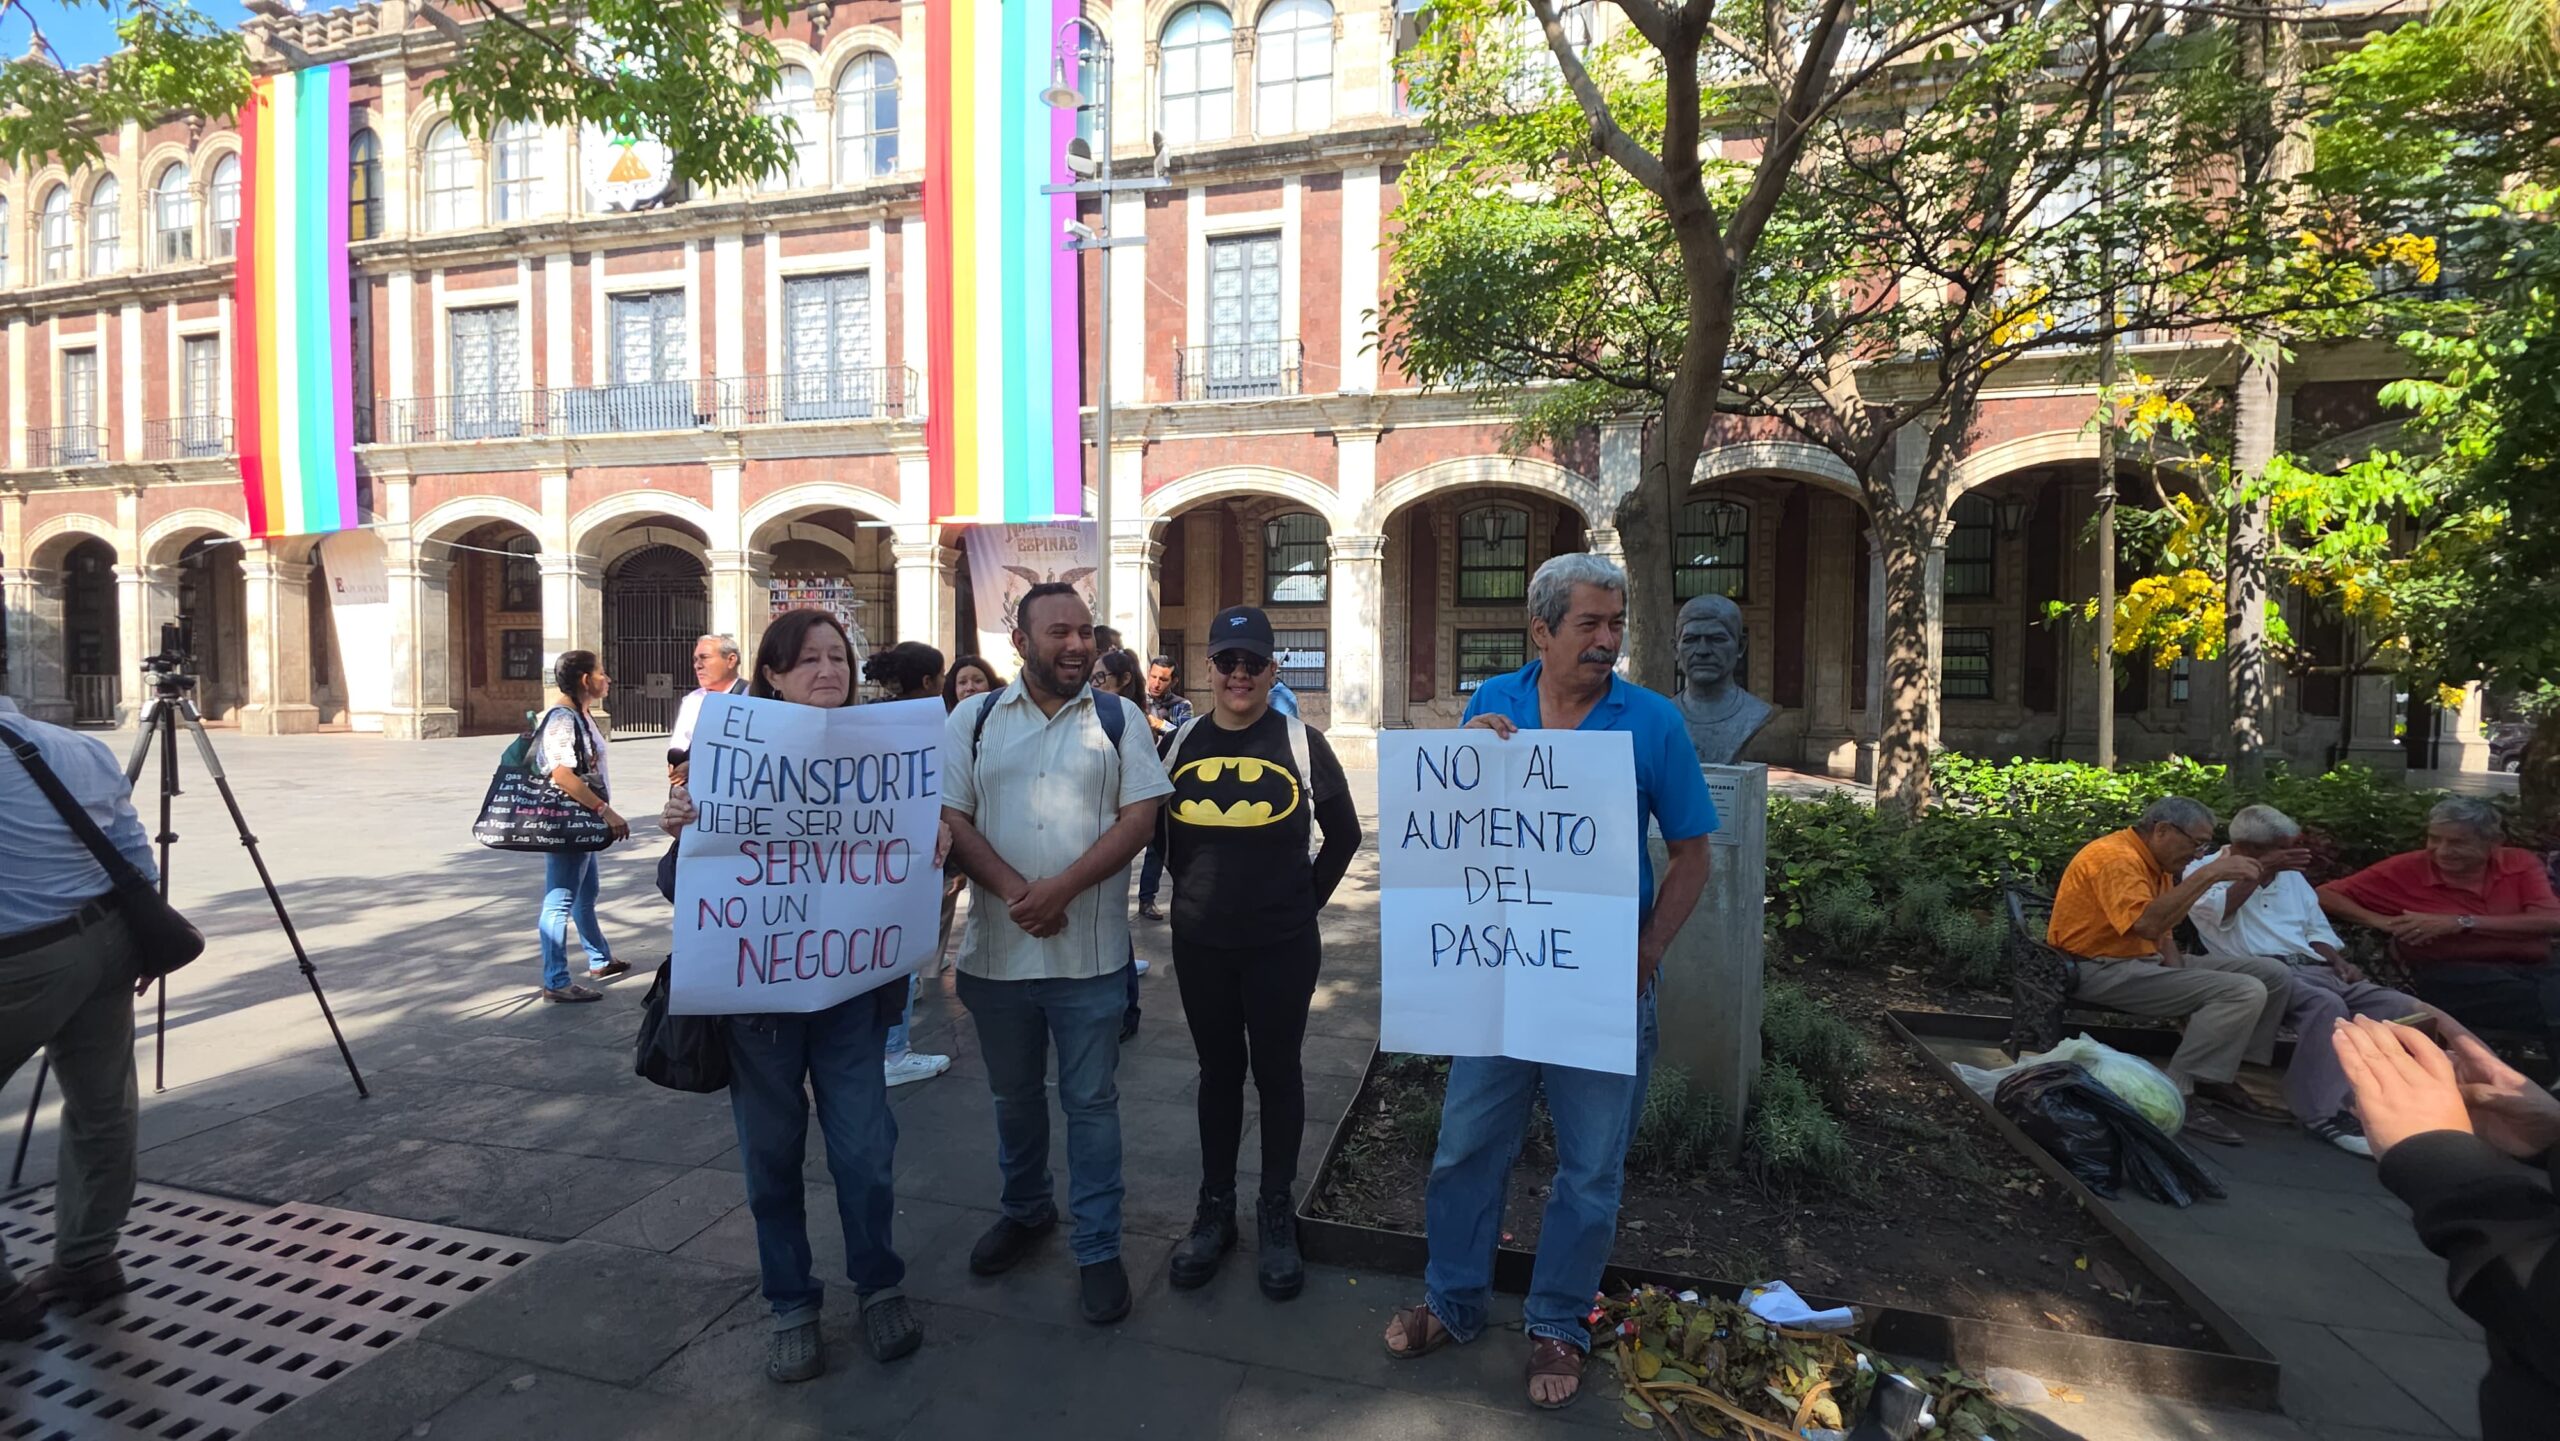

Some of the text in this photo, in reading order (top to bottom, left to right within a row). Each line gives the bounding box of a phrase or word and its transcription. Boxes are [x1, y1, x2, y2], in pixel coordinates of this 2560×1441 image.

[1017, 536, 1078, 552] ESPINAS
[723, 705, 765, 744] EL
[706, 741, 937, 805] TRANSPORTE
[1417, 744, 1569, 792] NO AL
[697, 800, 894, 837] DEBE SER UN
[1401, 808, 1596, 855] AUMENTO
[736, 838, 910, 886] SERVICIO
[1464, 866, 1553, 905] DEL
[697, 893, 808, 930] NO UN
[737, 924, 903, 987] NEGOCIO
[1431, 923, 1579, 969] PASAJE
